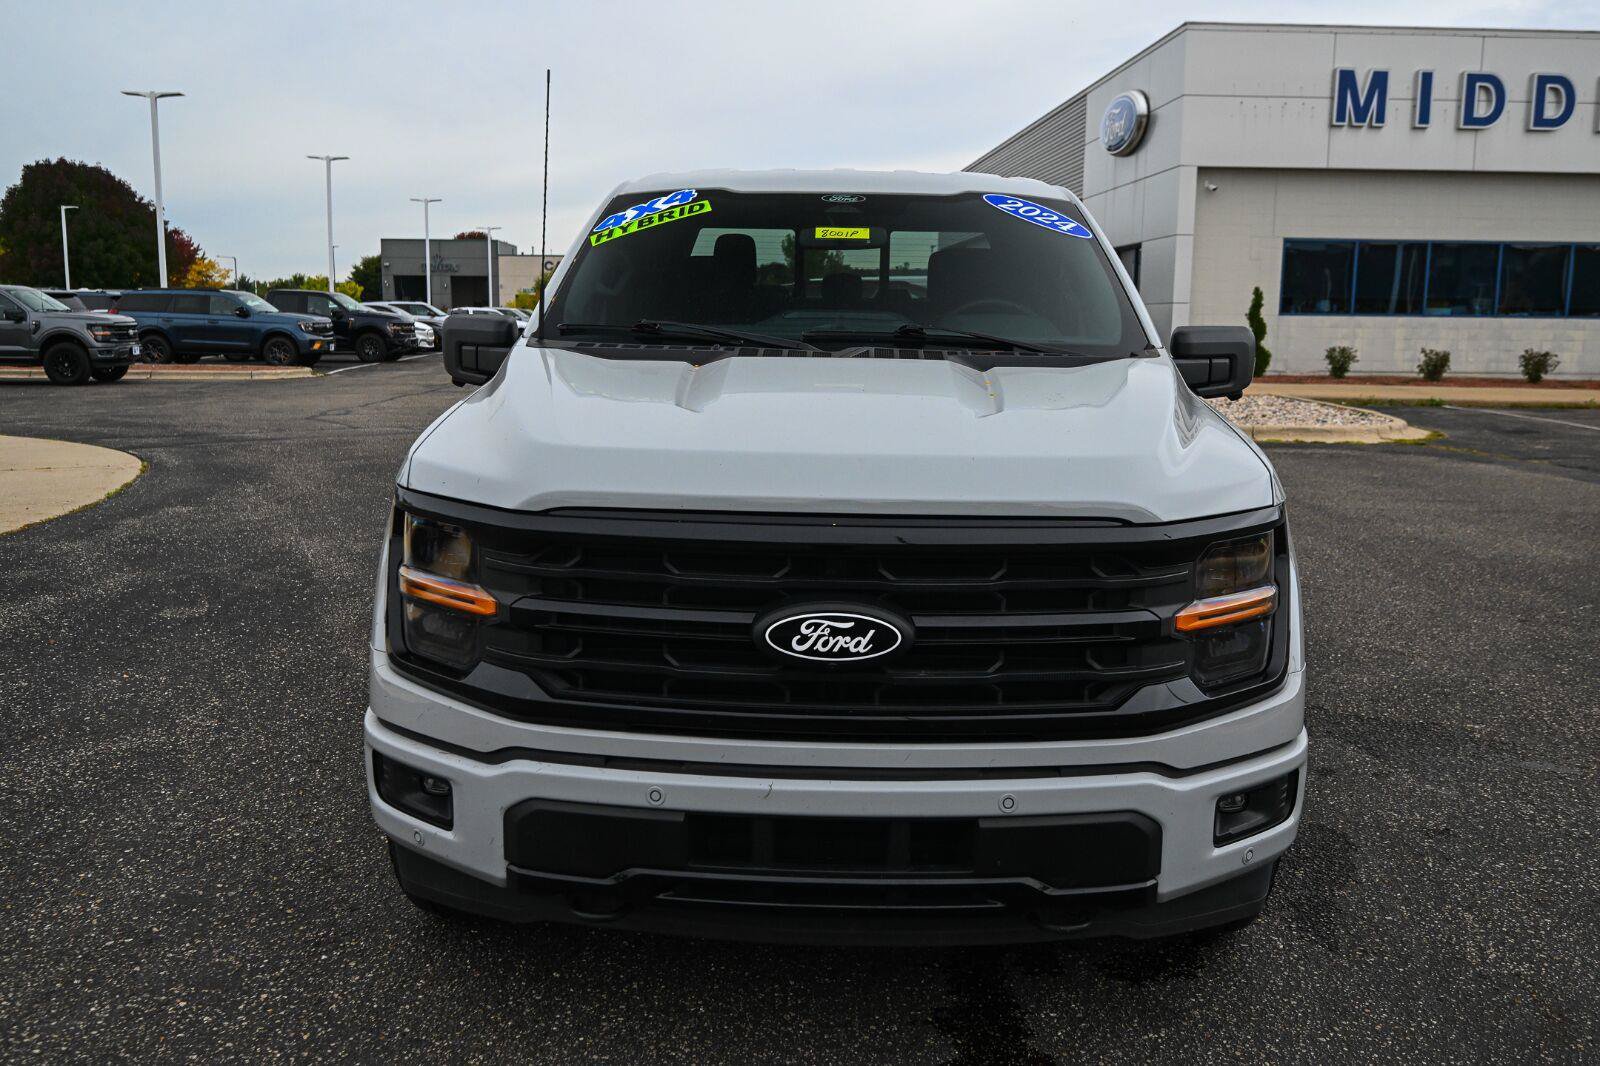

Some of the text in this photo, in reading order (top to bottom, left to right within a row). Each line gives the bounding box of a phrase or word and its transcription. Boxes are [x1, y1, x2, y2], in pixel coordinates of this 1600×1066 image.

[1332, 68, 1600, 134] MIDD
[594, 202, 706, 245] HYBRID
[998, 200, 1077, 231] 2024
[821, 229, 859, 238] 8001P
[791, 619, 876, 653] Ford
